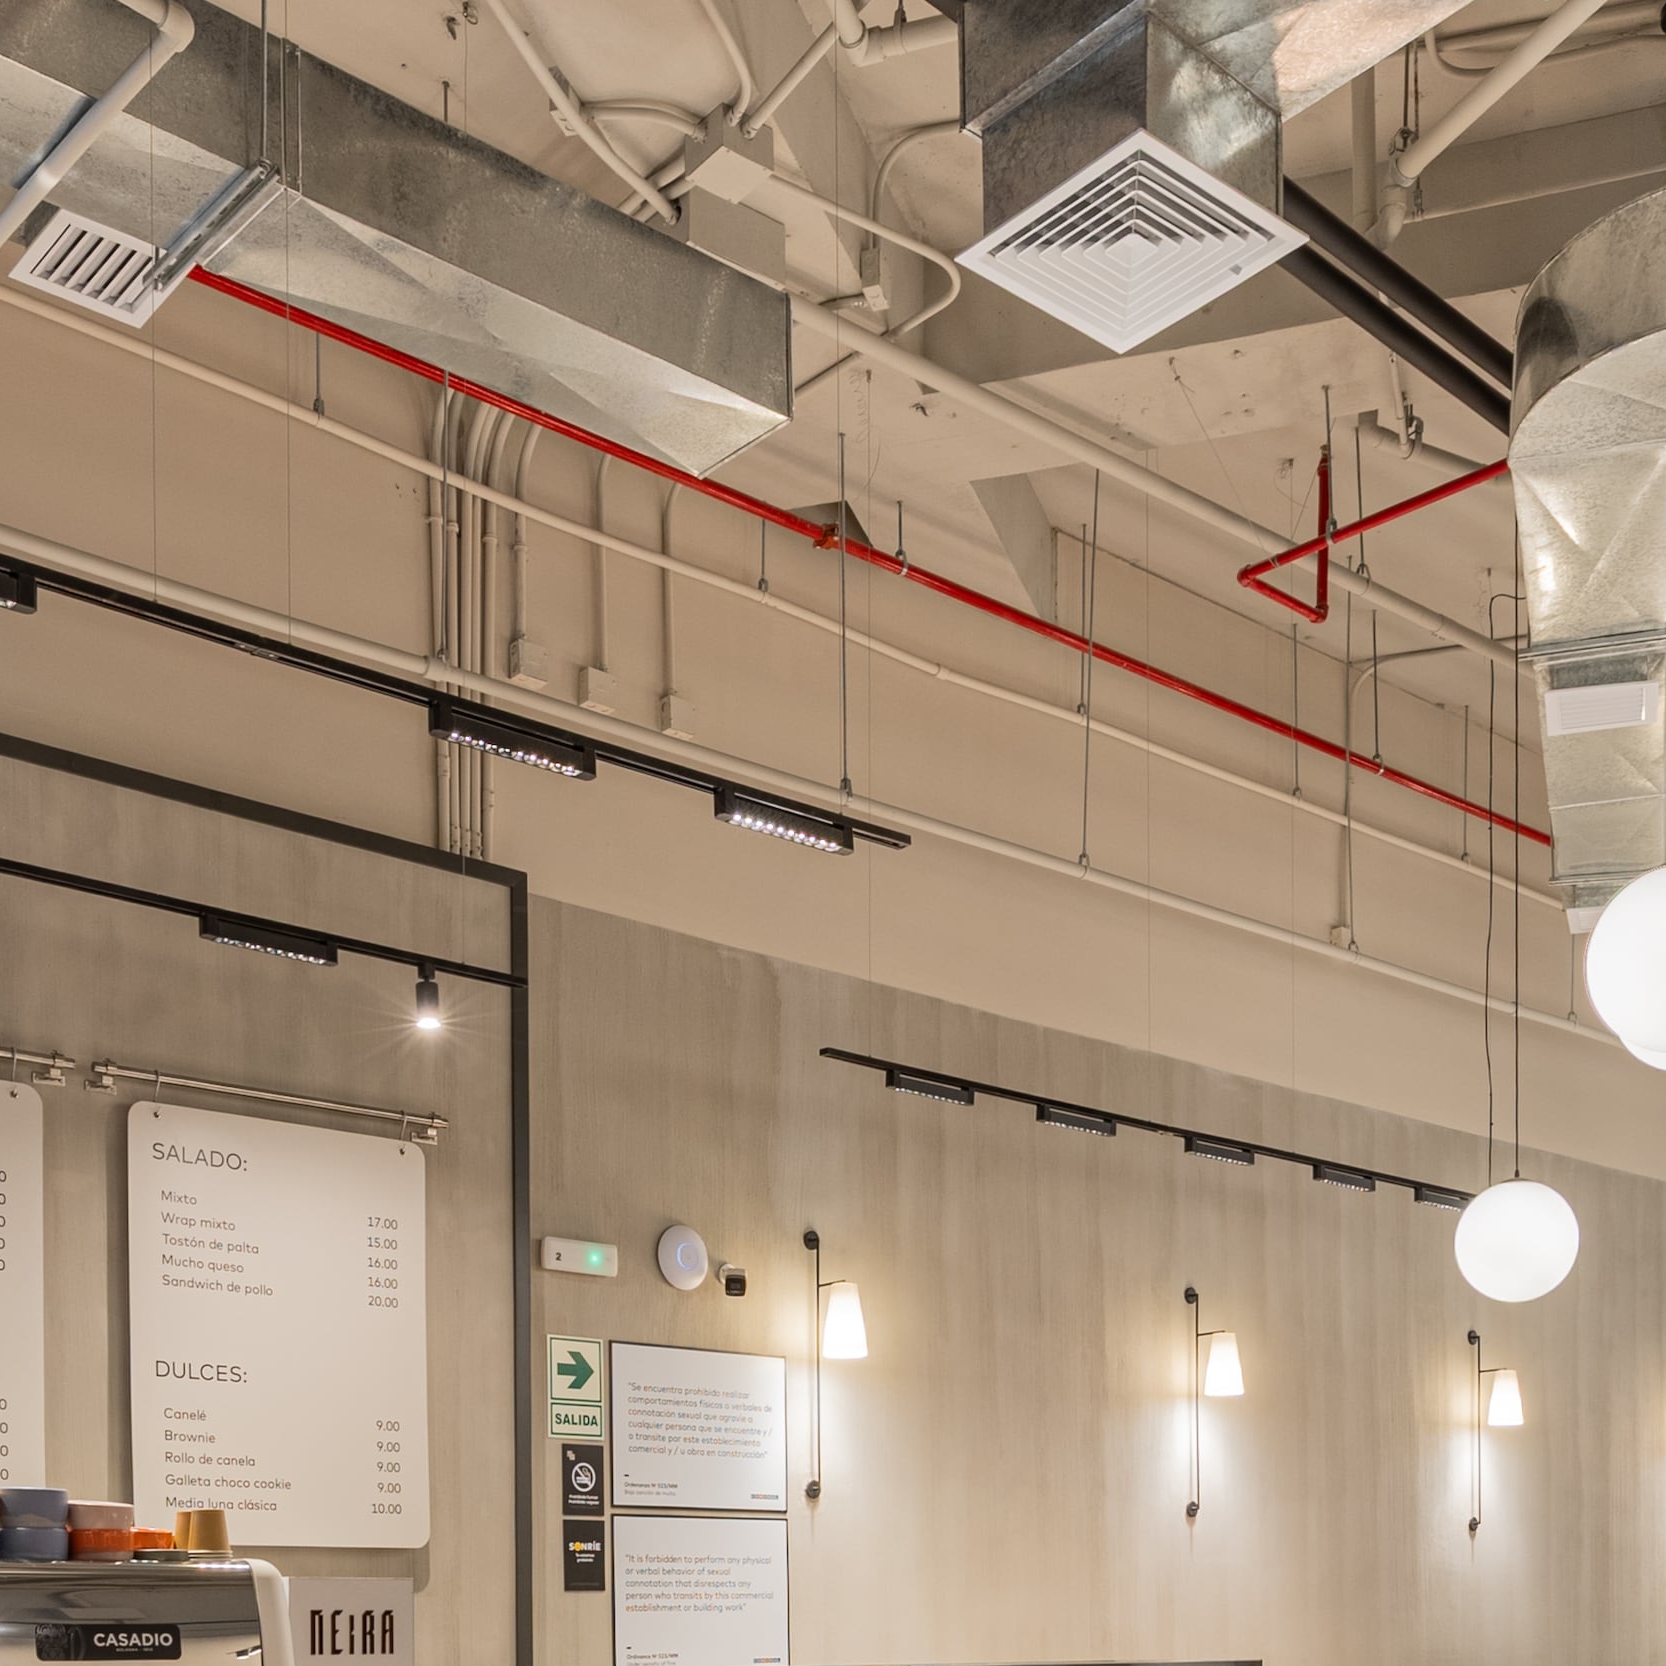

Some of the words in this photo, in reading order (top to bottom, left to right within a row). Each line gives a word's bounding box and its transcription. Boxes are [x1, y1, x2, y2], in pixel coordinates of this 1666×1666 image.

[153, 1142, 247, 1171] SALADO:
[161, 1190, 197, 1206] Mixto
[367, 1216, 398, 1230] 17.00
[161, 1211, 196, 1229] Wrap
[200, 1217, 236, 1231] mixto
[367, 1236, 397, 1250] 15.00
[163, 1234, 205, 1249] Tostón
[209, 1238, 223, 1250] de
[227, 1241, 259, 1254] palta
[367, 1257, 398, 1270] 16.00
[555, 1252, 562, 1261] 2
[162, 1254, 204, 1269] Mucho
[207, 1262, 244, 1273] queso
[367, 1276, 398, 1289] 16.00
[162, 1274, 223, 1291] Sandwich
[226, 1281, 241, 1293] de
[245, 1284, 273, 1296] pollo
[368, 1295, 398, 1308] 20.00
[156, 1360, 247, 1383] DULCES:
[643, 1385, 683, 1394] encuentra
[164, 1408, 207, 1421] Canelé
[376, 1420, 400, 1432] 9.00
[555, 1413, 598, 1427] SALIDA
[628, 1420, 663, 1429] cualquier
[165, 1429, 215, 1443] Brownie
[376, 1441, 400, 1453] 9.00
[165, 1451, 195, 1464] Rollo
[199, 1453, 213, 1464] de
[216, 1455, 255, 1466] canela
[377, 1461, 401, 1473] 9.00
[165, 1474, 211, 1487] Galleta
[214, 1476, 250, 1488] choco
[253, 1478, 291, 1489] cookie
[377, 1482, 401, 1494] 9.00
[165, 1496, 204, 1508] Media
[208, 1498, 234, 1509] luna
[237, 1500, 277, 1511] clásica
[372, 1503, 402, 1514] 10.00
[645, 1555, 682, 1563] forbidden
[694, 1556, 726, 1564] perform
[662, 1567, 695, 1575] behavior
[694, 1580, 736, 1588] disrespects
[625, 1603, 681, 1612] establishment
[694, 1603, 723, 1613] building
[93, 1633, 173, 1647] CASADIO
[310, 1609, 395, 1656] NEIRA
